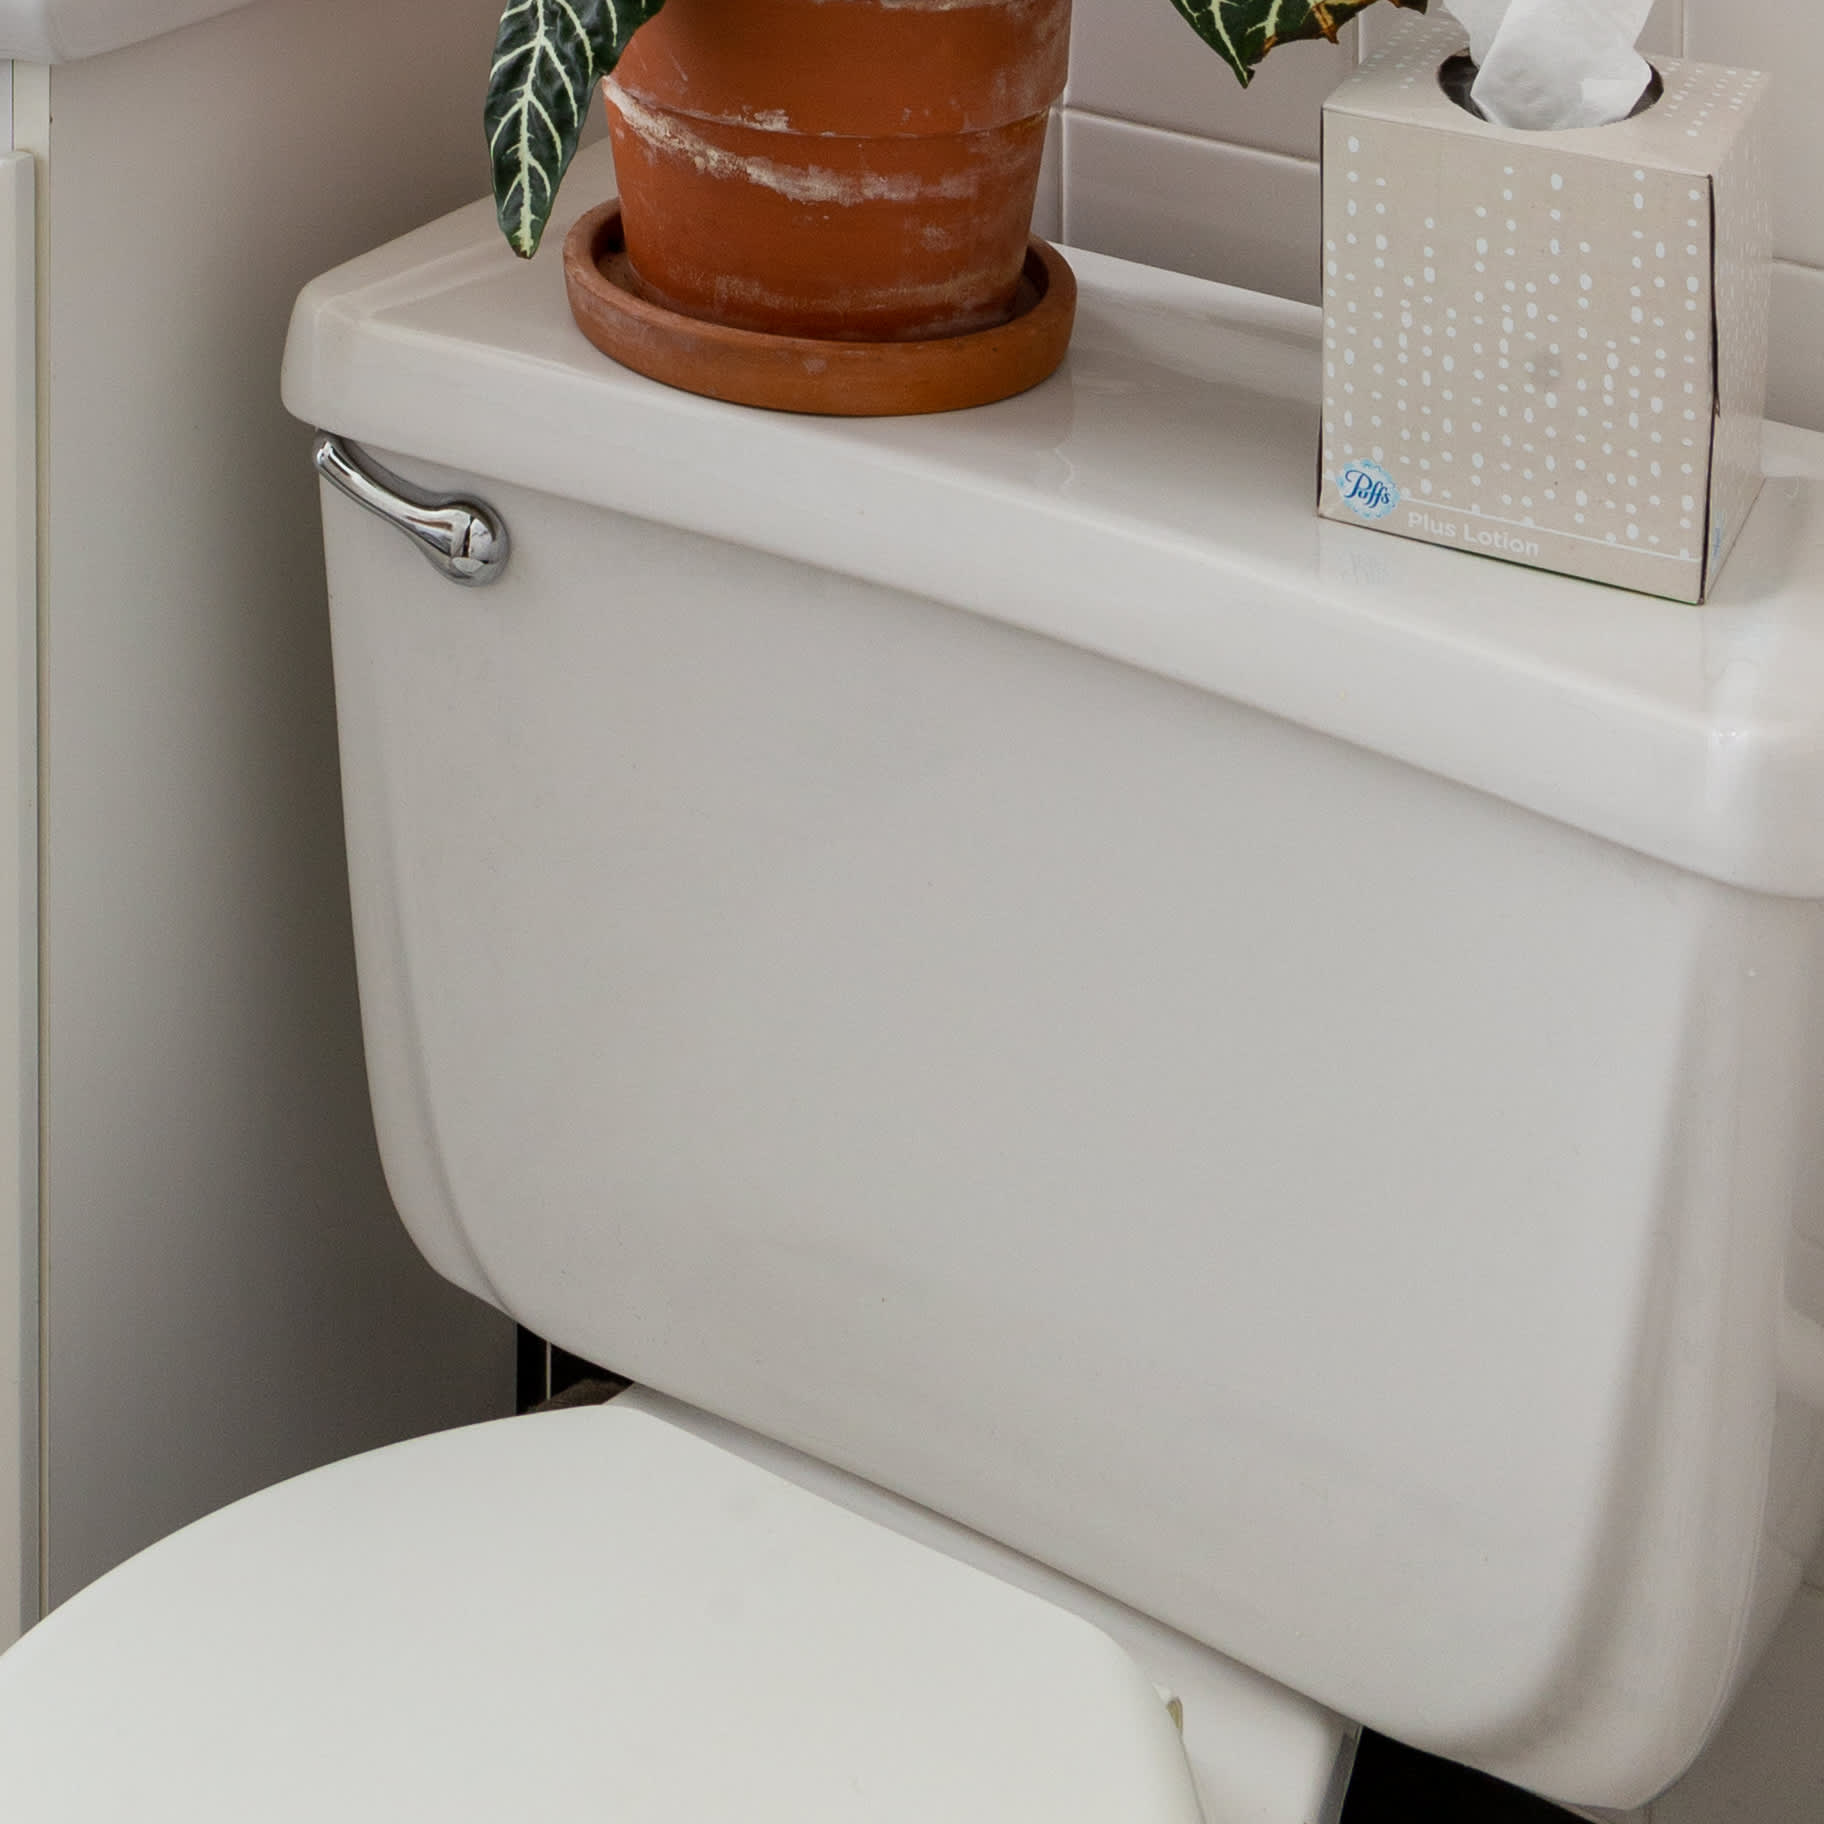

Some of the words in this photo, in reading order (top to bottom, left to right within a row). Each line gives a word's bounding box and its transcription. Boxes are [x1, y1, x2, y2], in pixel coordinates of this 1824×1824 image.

[1344, 469, 1391, 508] Puffs
[1408, 512, 1456, 537] Plus
[1463, 523, 1539, 557] Lotion
